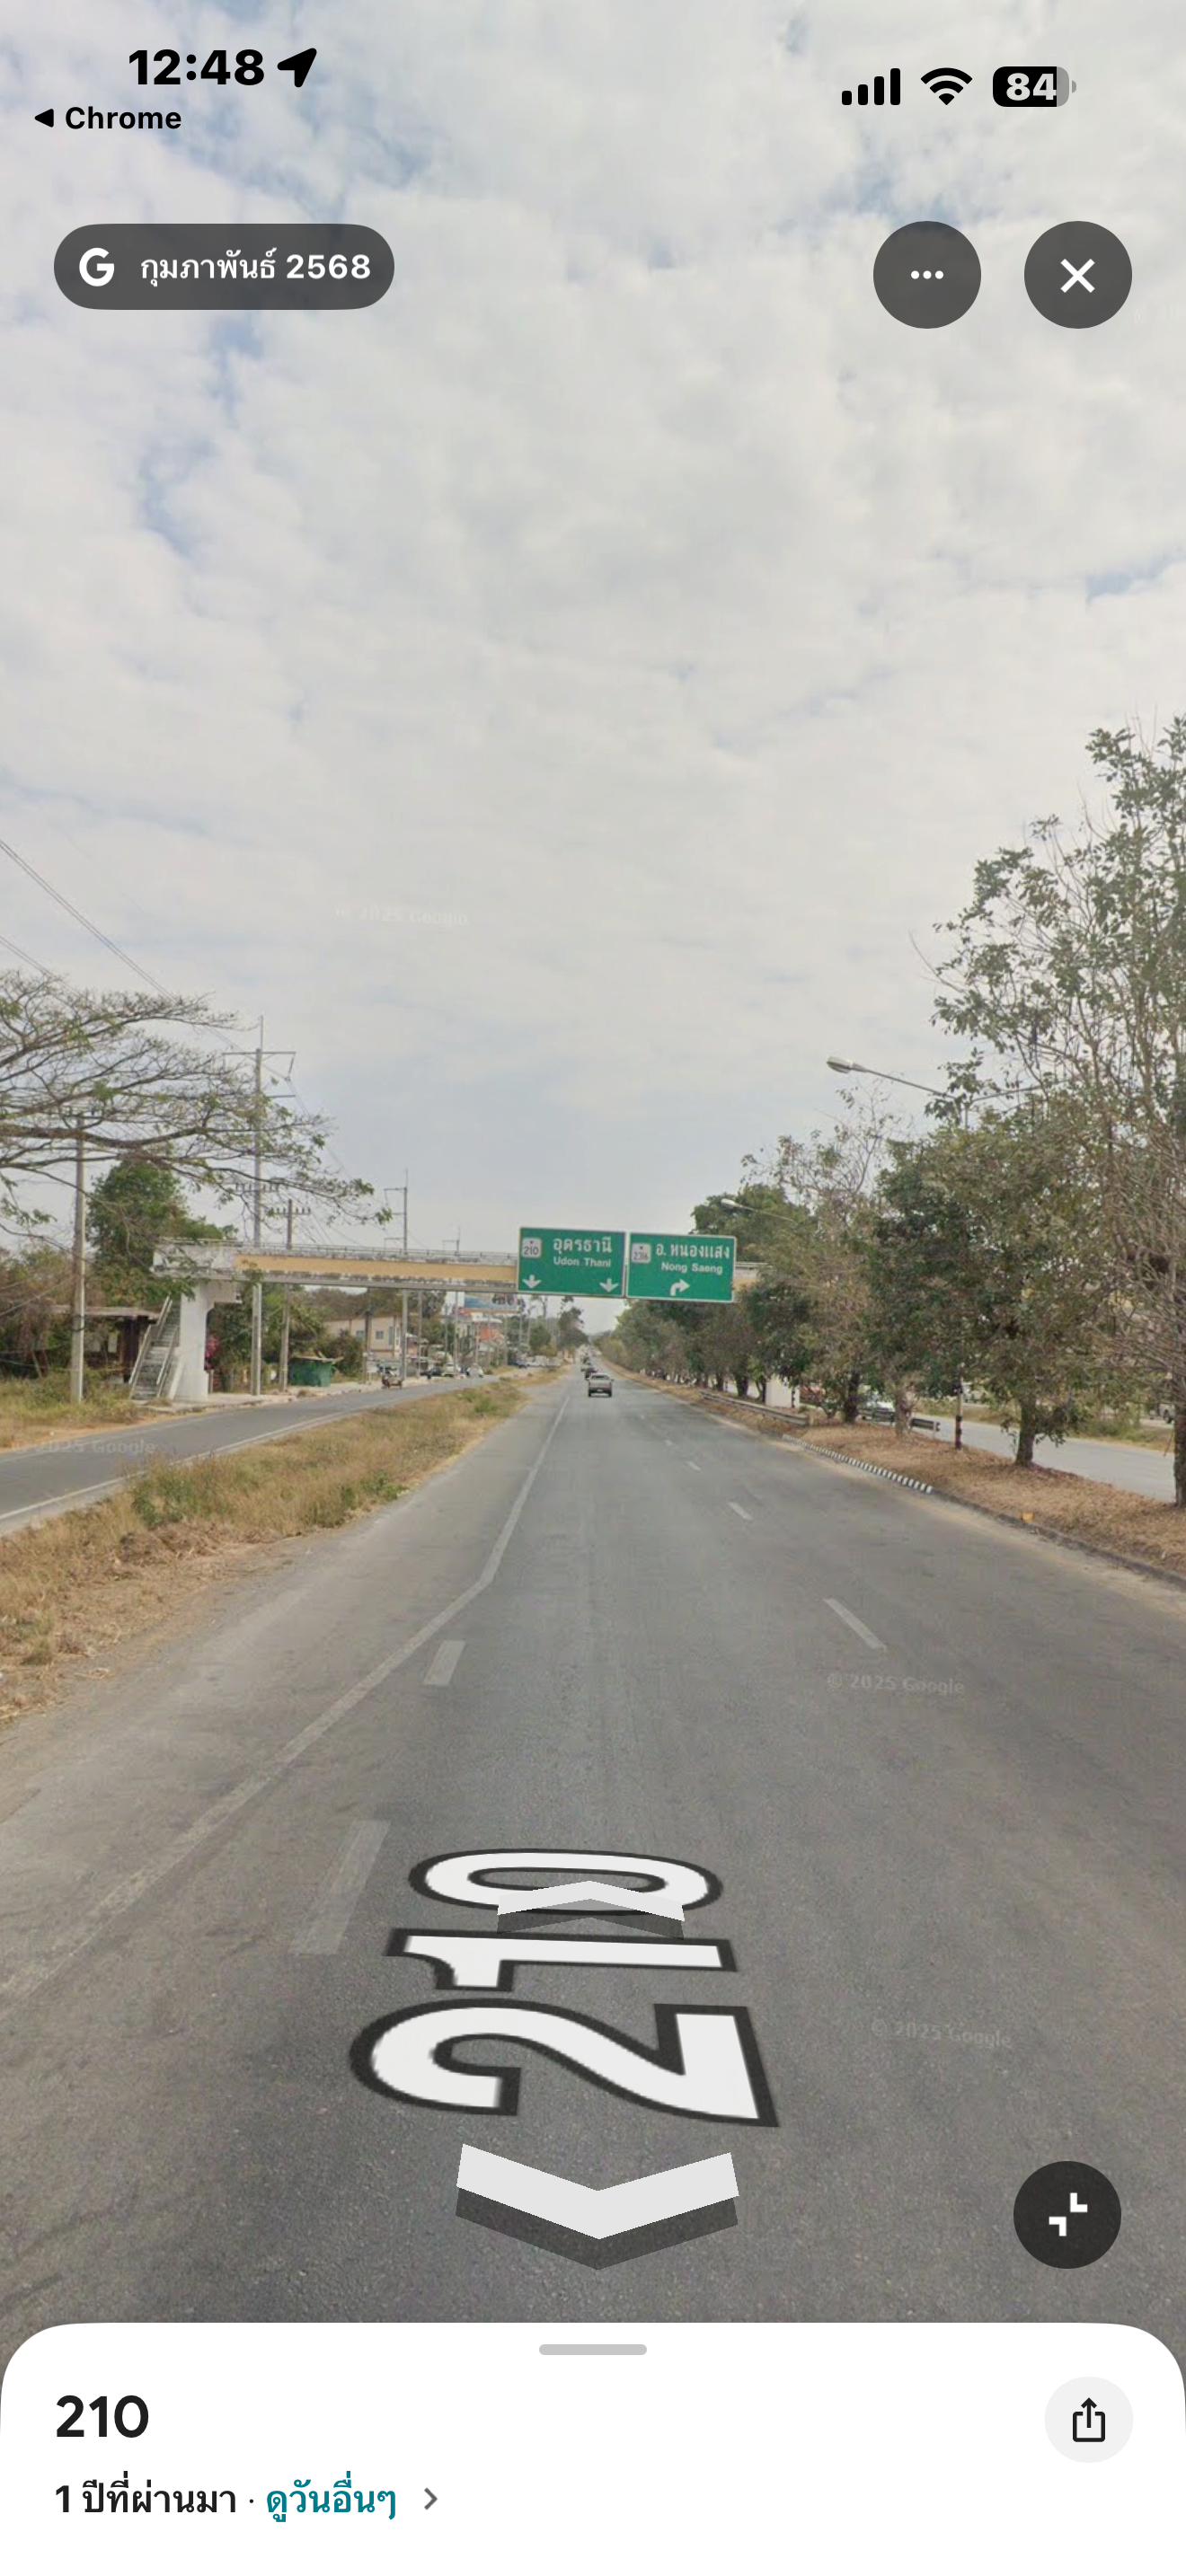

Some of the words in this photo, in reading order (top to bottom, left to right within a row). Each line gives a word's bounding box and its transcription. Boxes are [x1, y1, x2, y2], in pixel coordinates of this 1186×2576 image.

[524, 1246, 539, 1255] 210
[553, 1237, 612, 1255] อุดรธานี
[553, 1257, 580, 1266] Udon
[584, 1257, 611, 1267] Thani
[661, 1262, 687, 1274] Nong
[692, 1263, 723, 1275] Saeng
